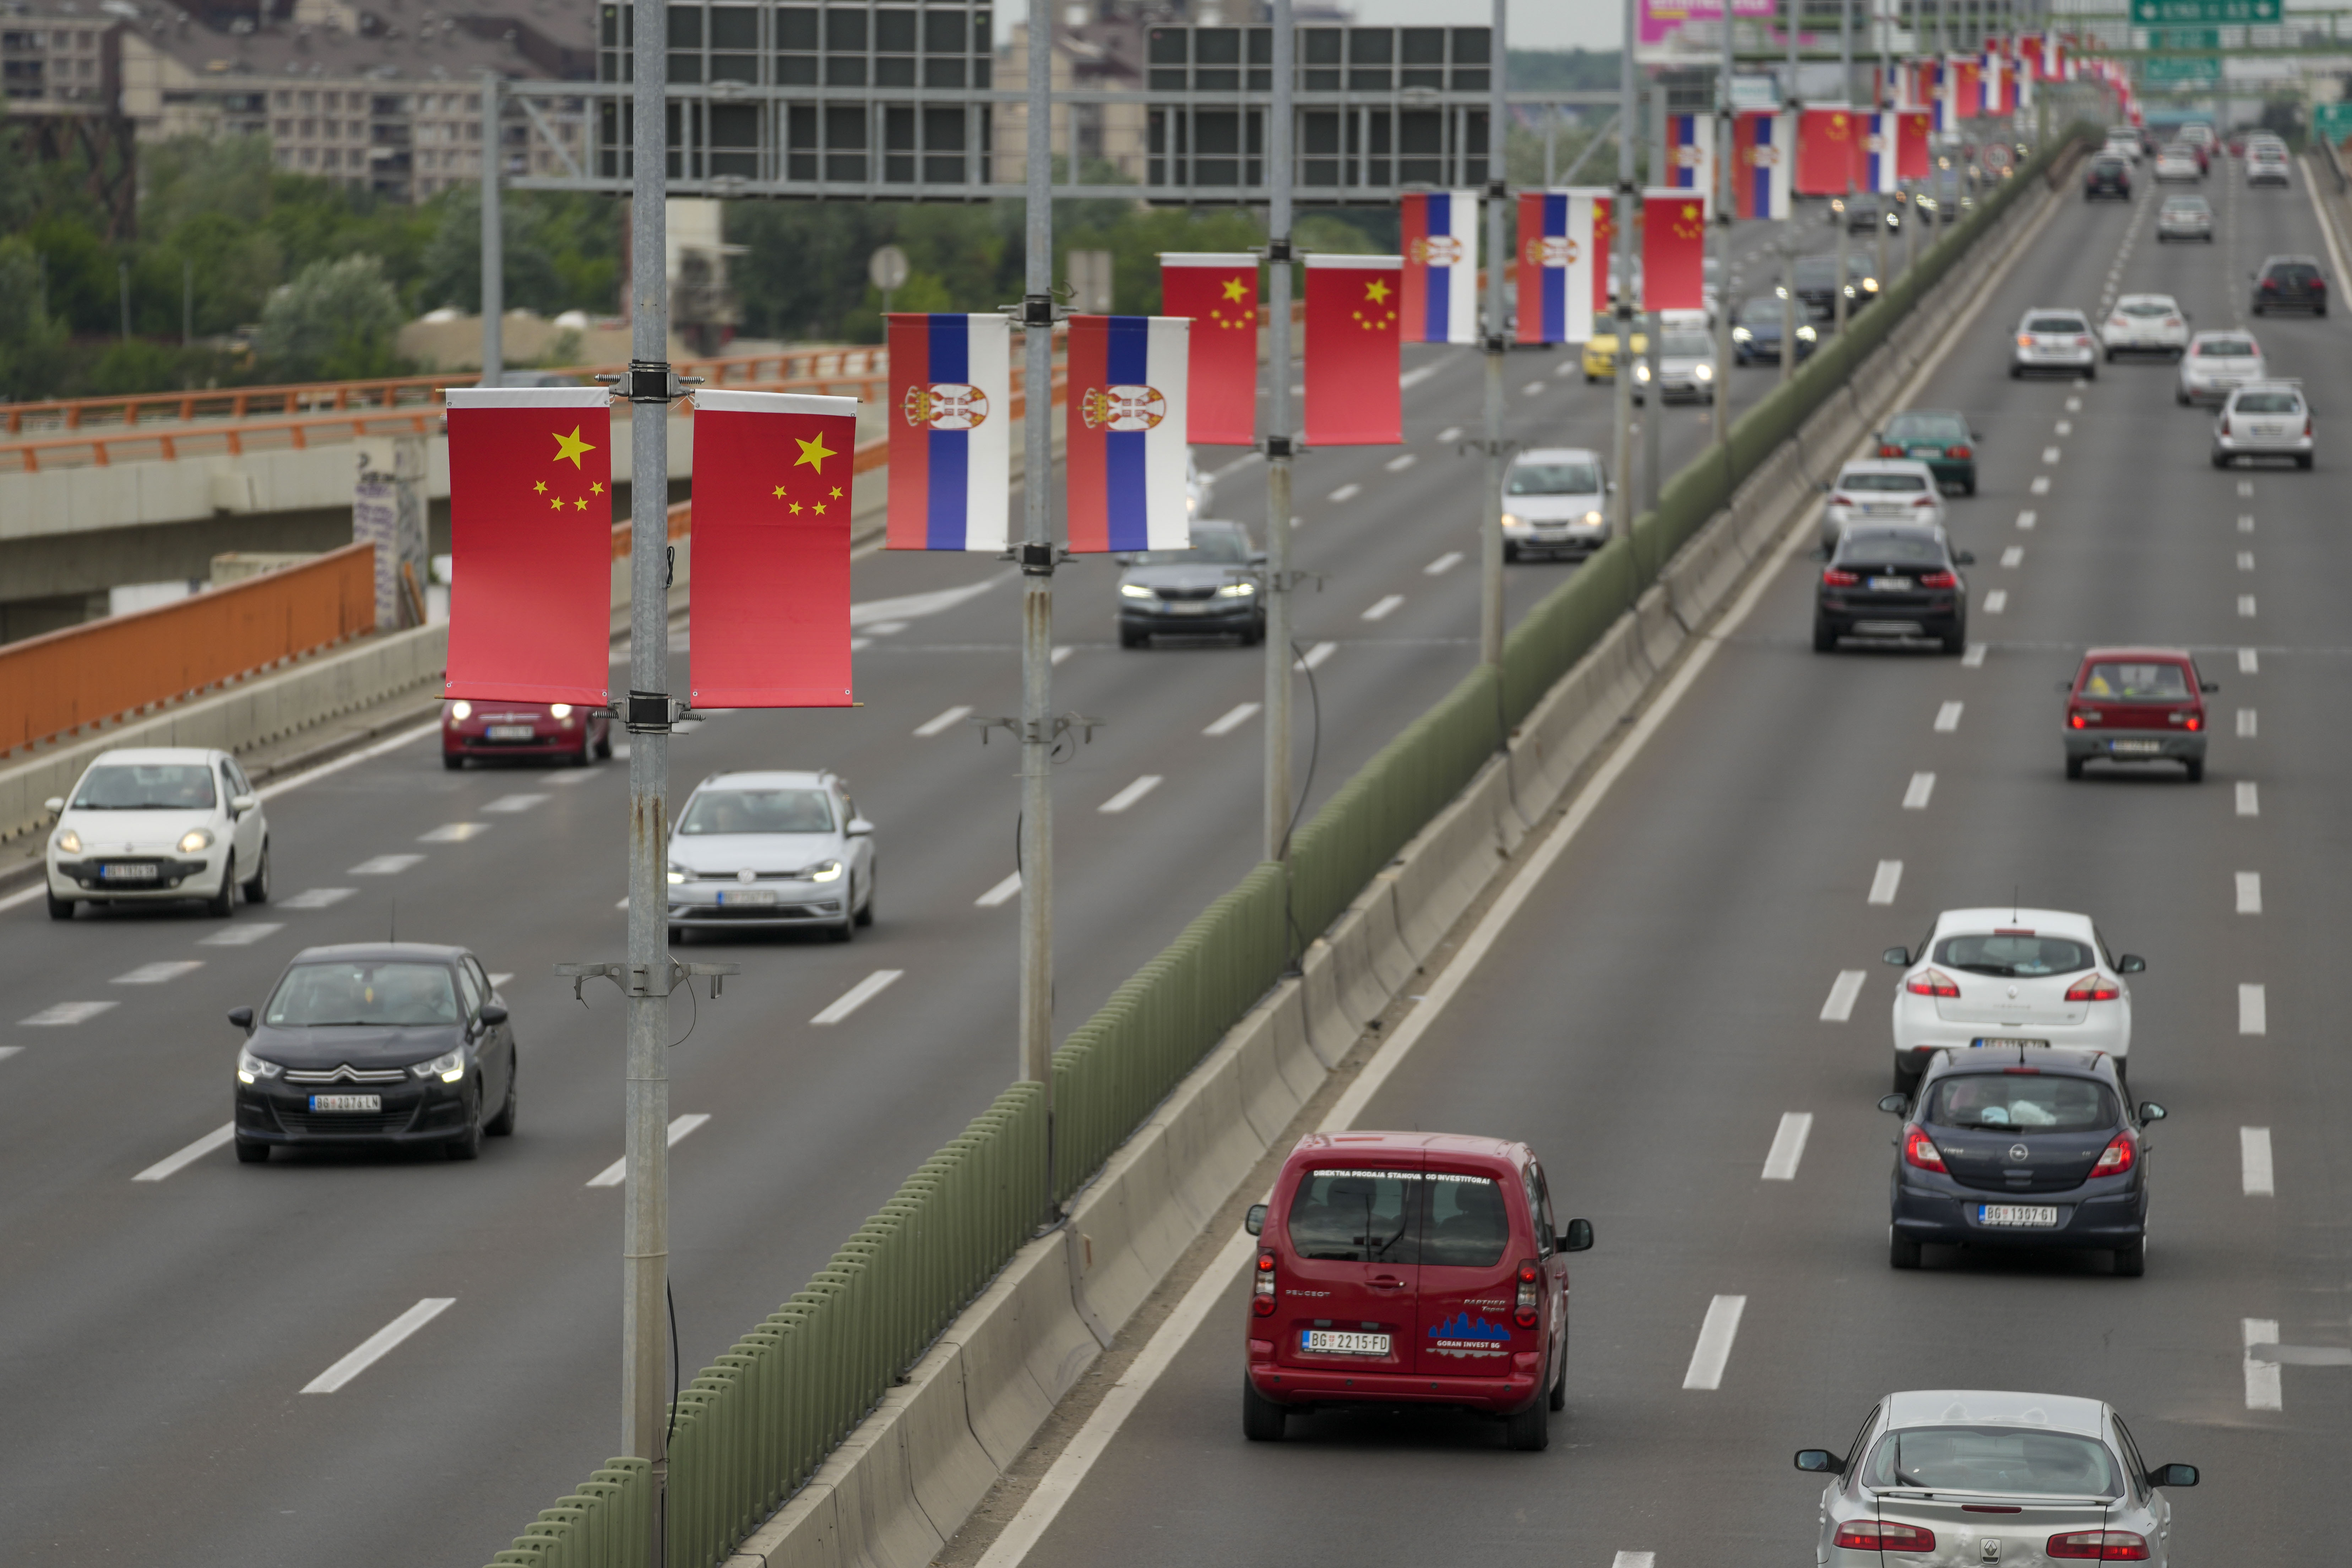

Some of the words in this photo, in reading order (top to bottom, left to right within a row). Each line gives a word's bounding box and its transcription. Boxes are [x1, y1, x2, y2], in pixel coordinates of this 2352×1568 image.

[317, 1097, 329, 1108] BG
[1988, 1207, 2001, 1219] BG
[1312, 1333, 1327, 1347] BG
